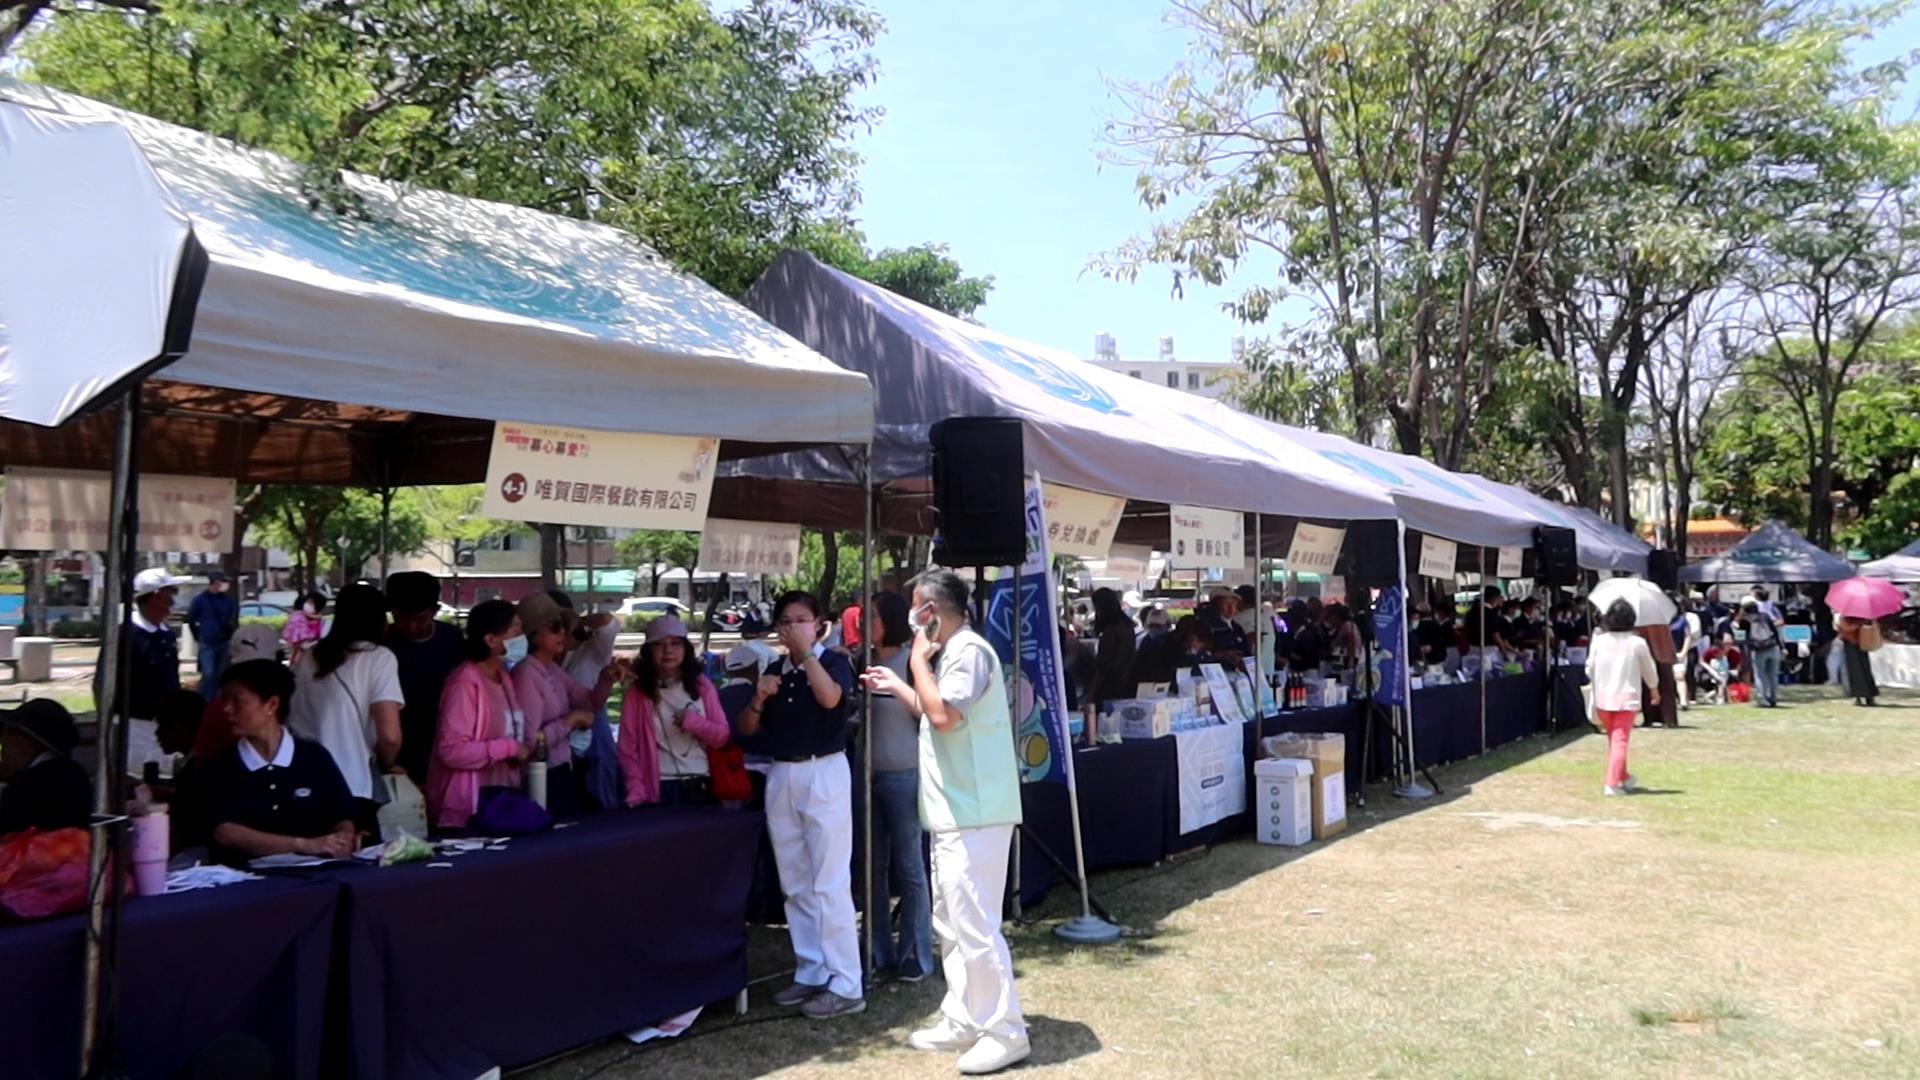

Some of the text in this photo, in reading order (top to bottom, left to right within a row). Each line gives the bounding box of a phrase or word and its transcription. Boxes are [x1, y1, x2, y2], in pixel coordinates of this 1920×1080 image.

[534, 479, 697, 512] 唯賀國際餐飲有限公司
